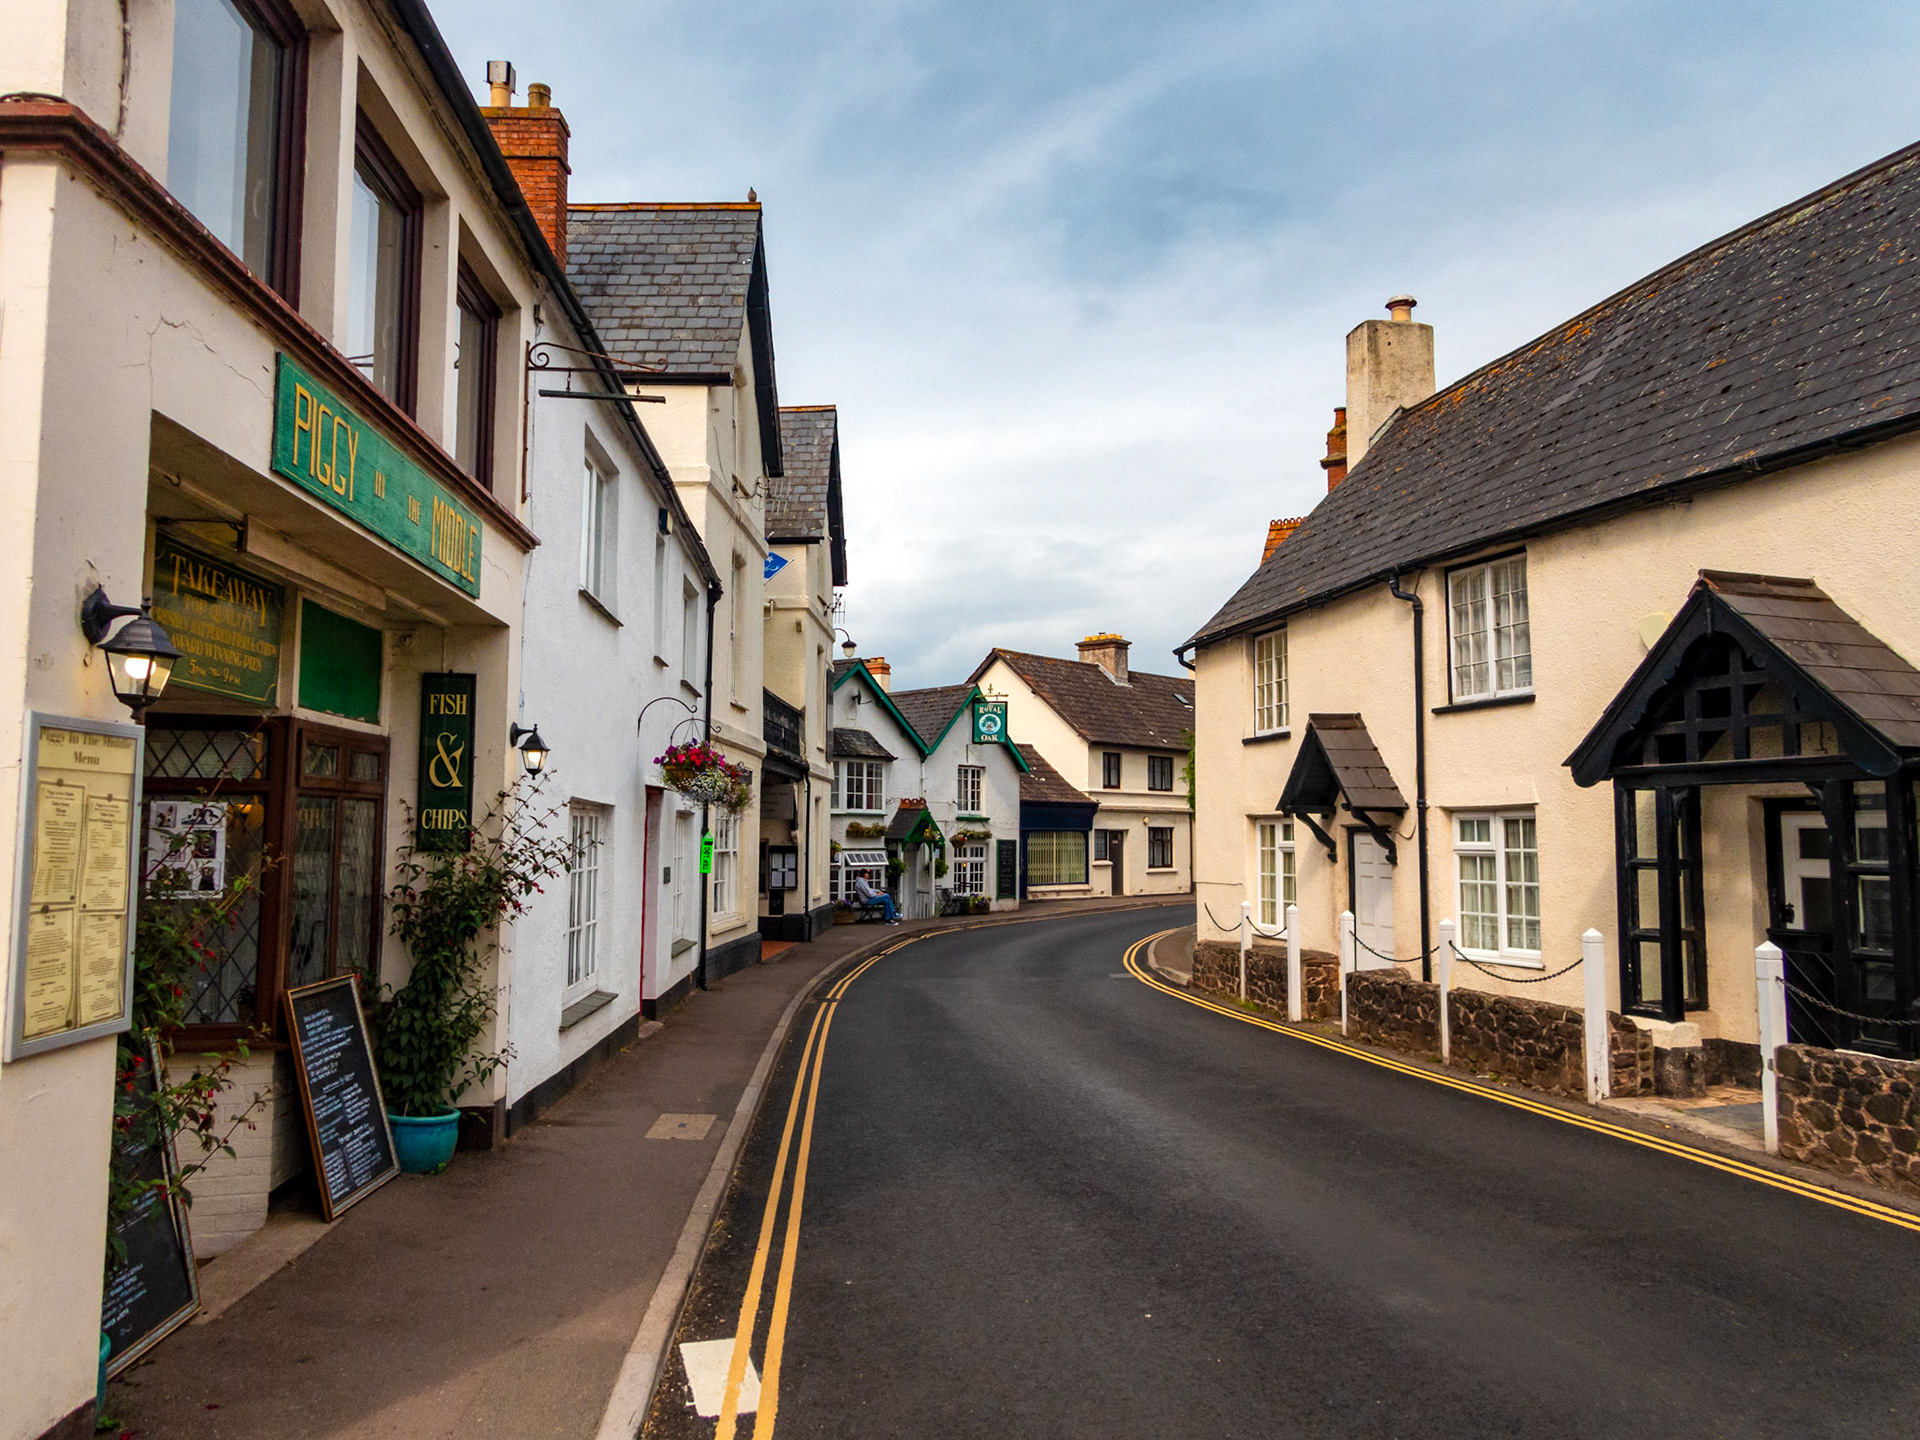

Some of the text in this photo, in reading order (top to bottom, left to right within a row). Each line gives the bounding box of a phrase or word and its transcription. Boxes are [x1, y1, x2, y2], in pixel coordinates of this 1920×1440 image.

[292, 382, 477, 584] PIGGY IN THE MIDDLE
[169, 553, 271, 628] TAKEAWAY
[184, 593, 253, 633] TOP QUALITY
[171, 633, 262, 673] AWARD WINNING PIES
[429, 694, 467, 715] FISH
[979, 706, 1002, 714] ROYAL
[74, 751, 100, 766] Menu
[429, 732, 465, 788] &
[421, 808, 467, 830] CHIPS
